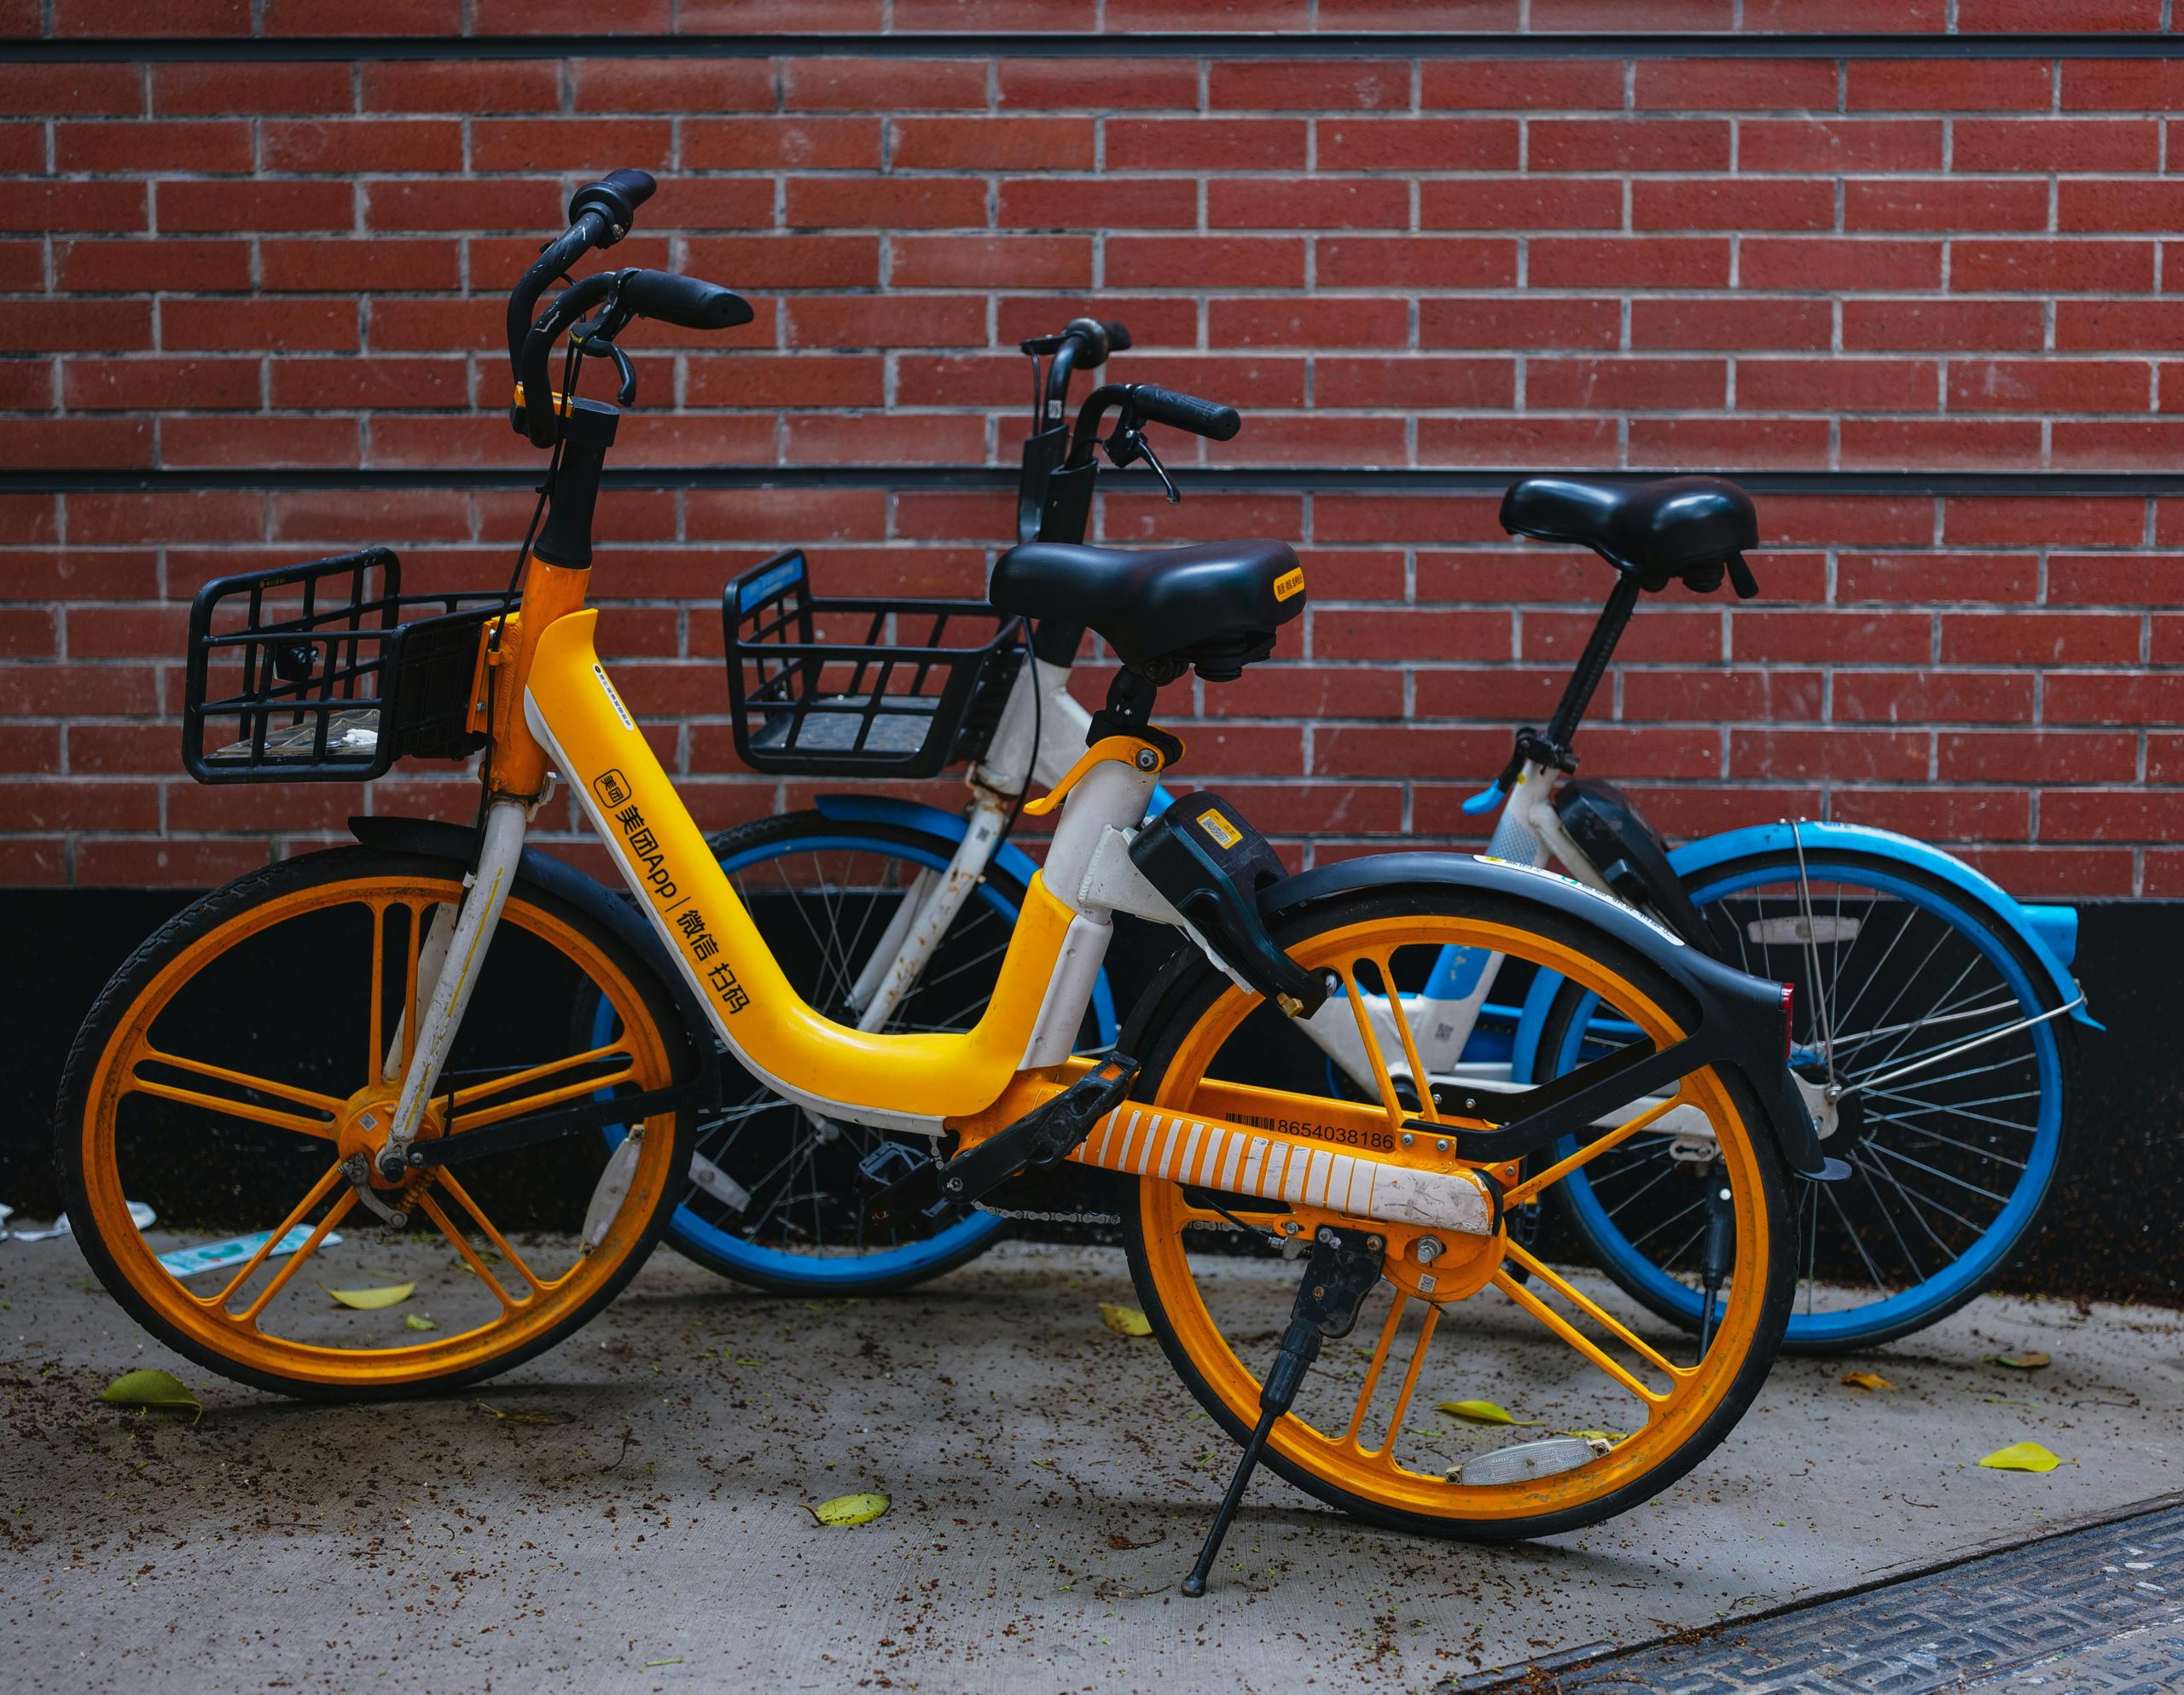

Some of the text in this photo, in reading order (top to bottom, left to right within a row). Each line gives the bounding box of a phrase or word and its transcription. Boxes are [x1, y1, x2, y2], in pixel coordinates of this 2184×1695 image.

[601, 775, 624, 804] 美团
[615, 804, 750, 1014] 美团App 微信 扫码
[1277, 1119, 1394, 1149] 8654038186
